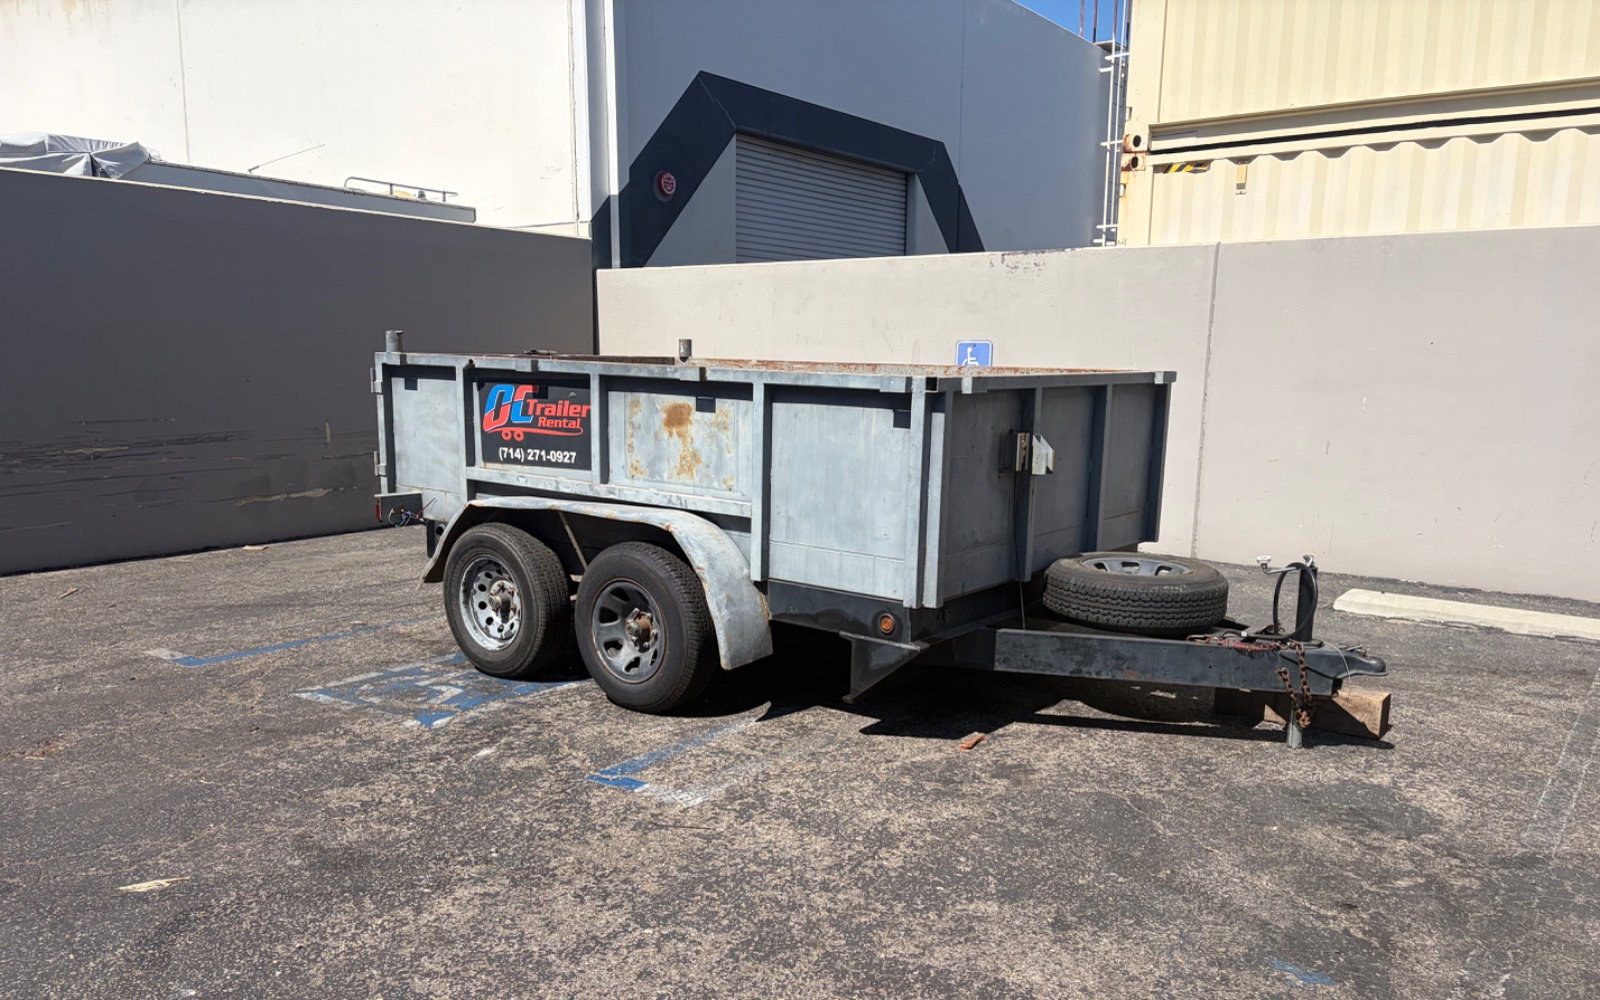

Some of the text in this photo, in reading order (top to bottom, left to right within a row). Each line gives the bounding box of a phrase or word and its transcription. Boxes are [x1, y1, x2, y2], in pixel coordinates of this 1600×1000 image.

[483, 384, 539, 432] OC
[527, 399, 592, 418] Trailer
[538, 416, 581, 429] Rental
[499, 447, 577, 464] (714) 271-0927
